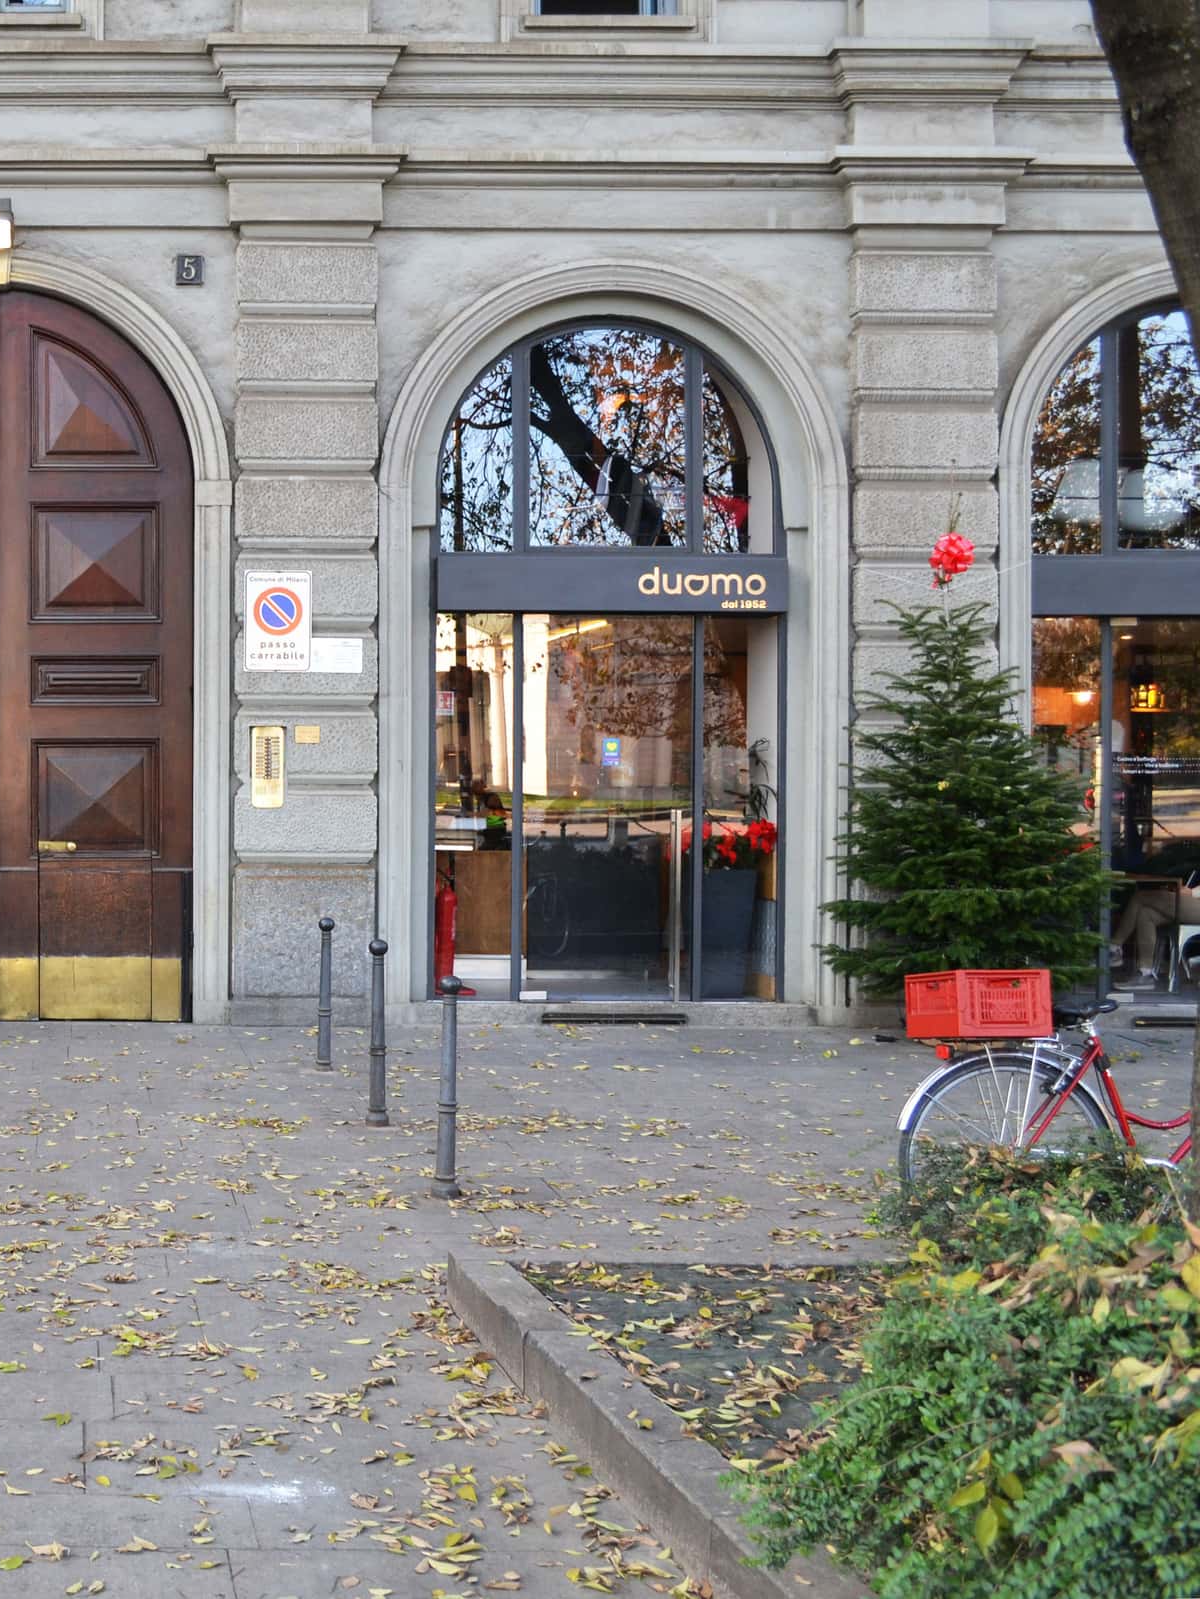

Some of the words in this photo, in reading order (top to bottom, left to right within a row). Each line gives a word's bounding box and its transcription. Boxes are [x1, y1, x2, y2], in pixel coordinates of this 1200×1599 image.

[182, 257, 196, 279] 5
[249, 575, 276, 583] Comune
[277, 575, 284, 583] di
[286, 575, 308, 583] Milano
[638, 566, 767, 596] duomo
[721, 599, 738, 609] dal
[740, 599, 768, 609] 1952
[260, 641, 296, 649] passo
[250, 651, 305, 660] carrabile
